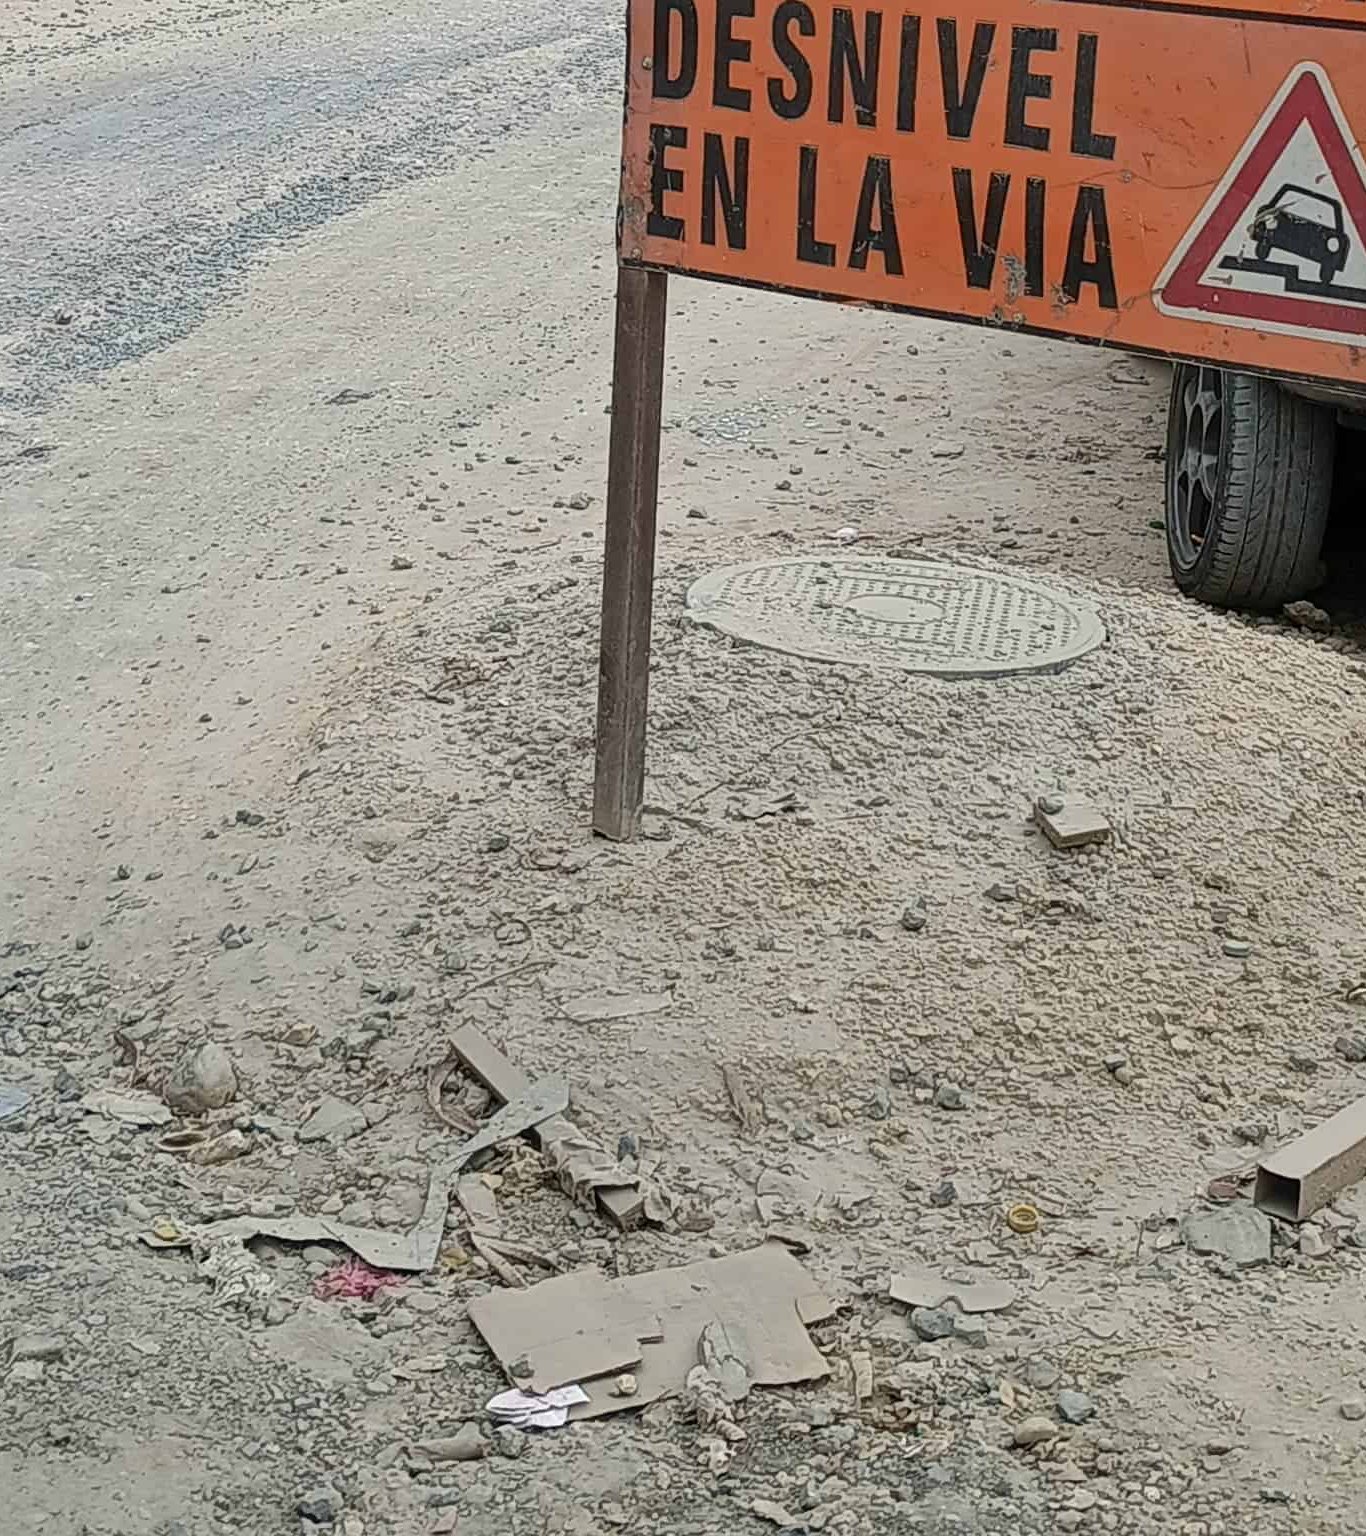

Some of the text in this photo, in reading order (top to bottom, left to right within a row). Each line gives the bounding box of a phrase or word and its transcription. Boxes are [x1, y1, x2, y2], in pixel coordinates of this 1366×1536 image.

[646, 123, 1120, 310] EN LA VIA
